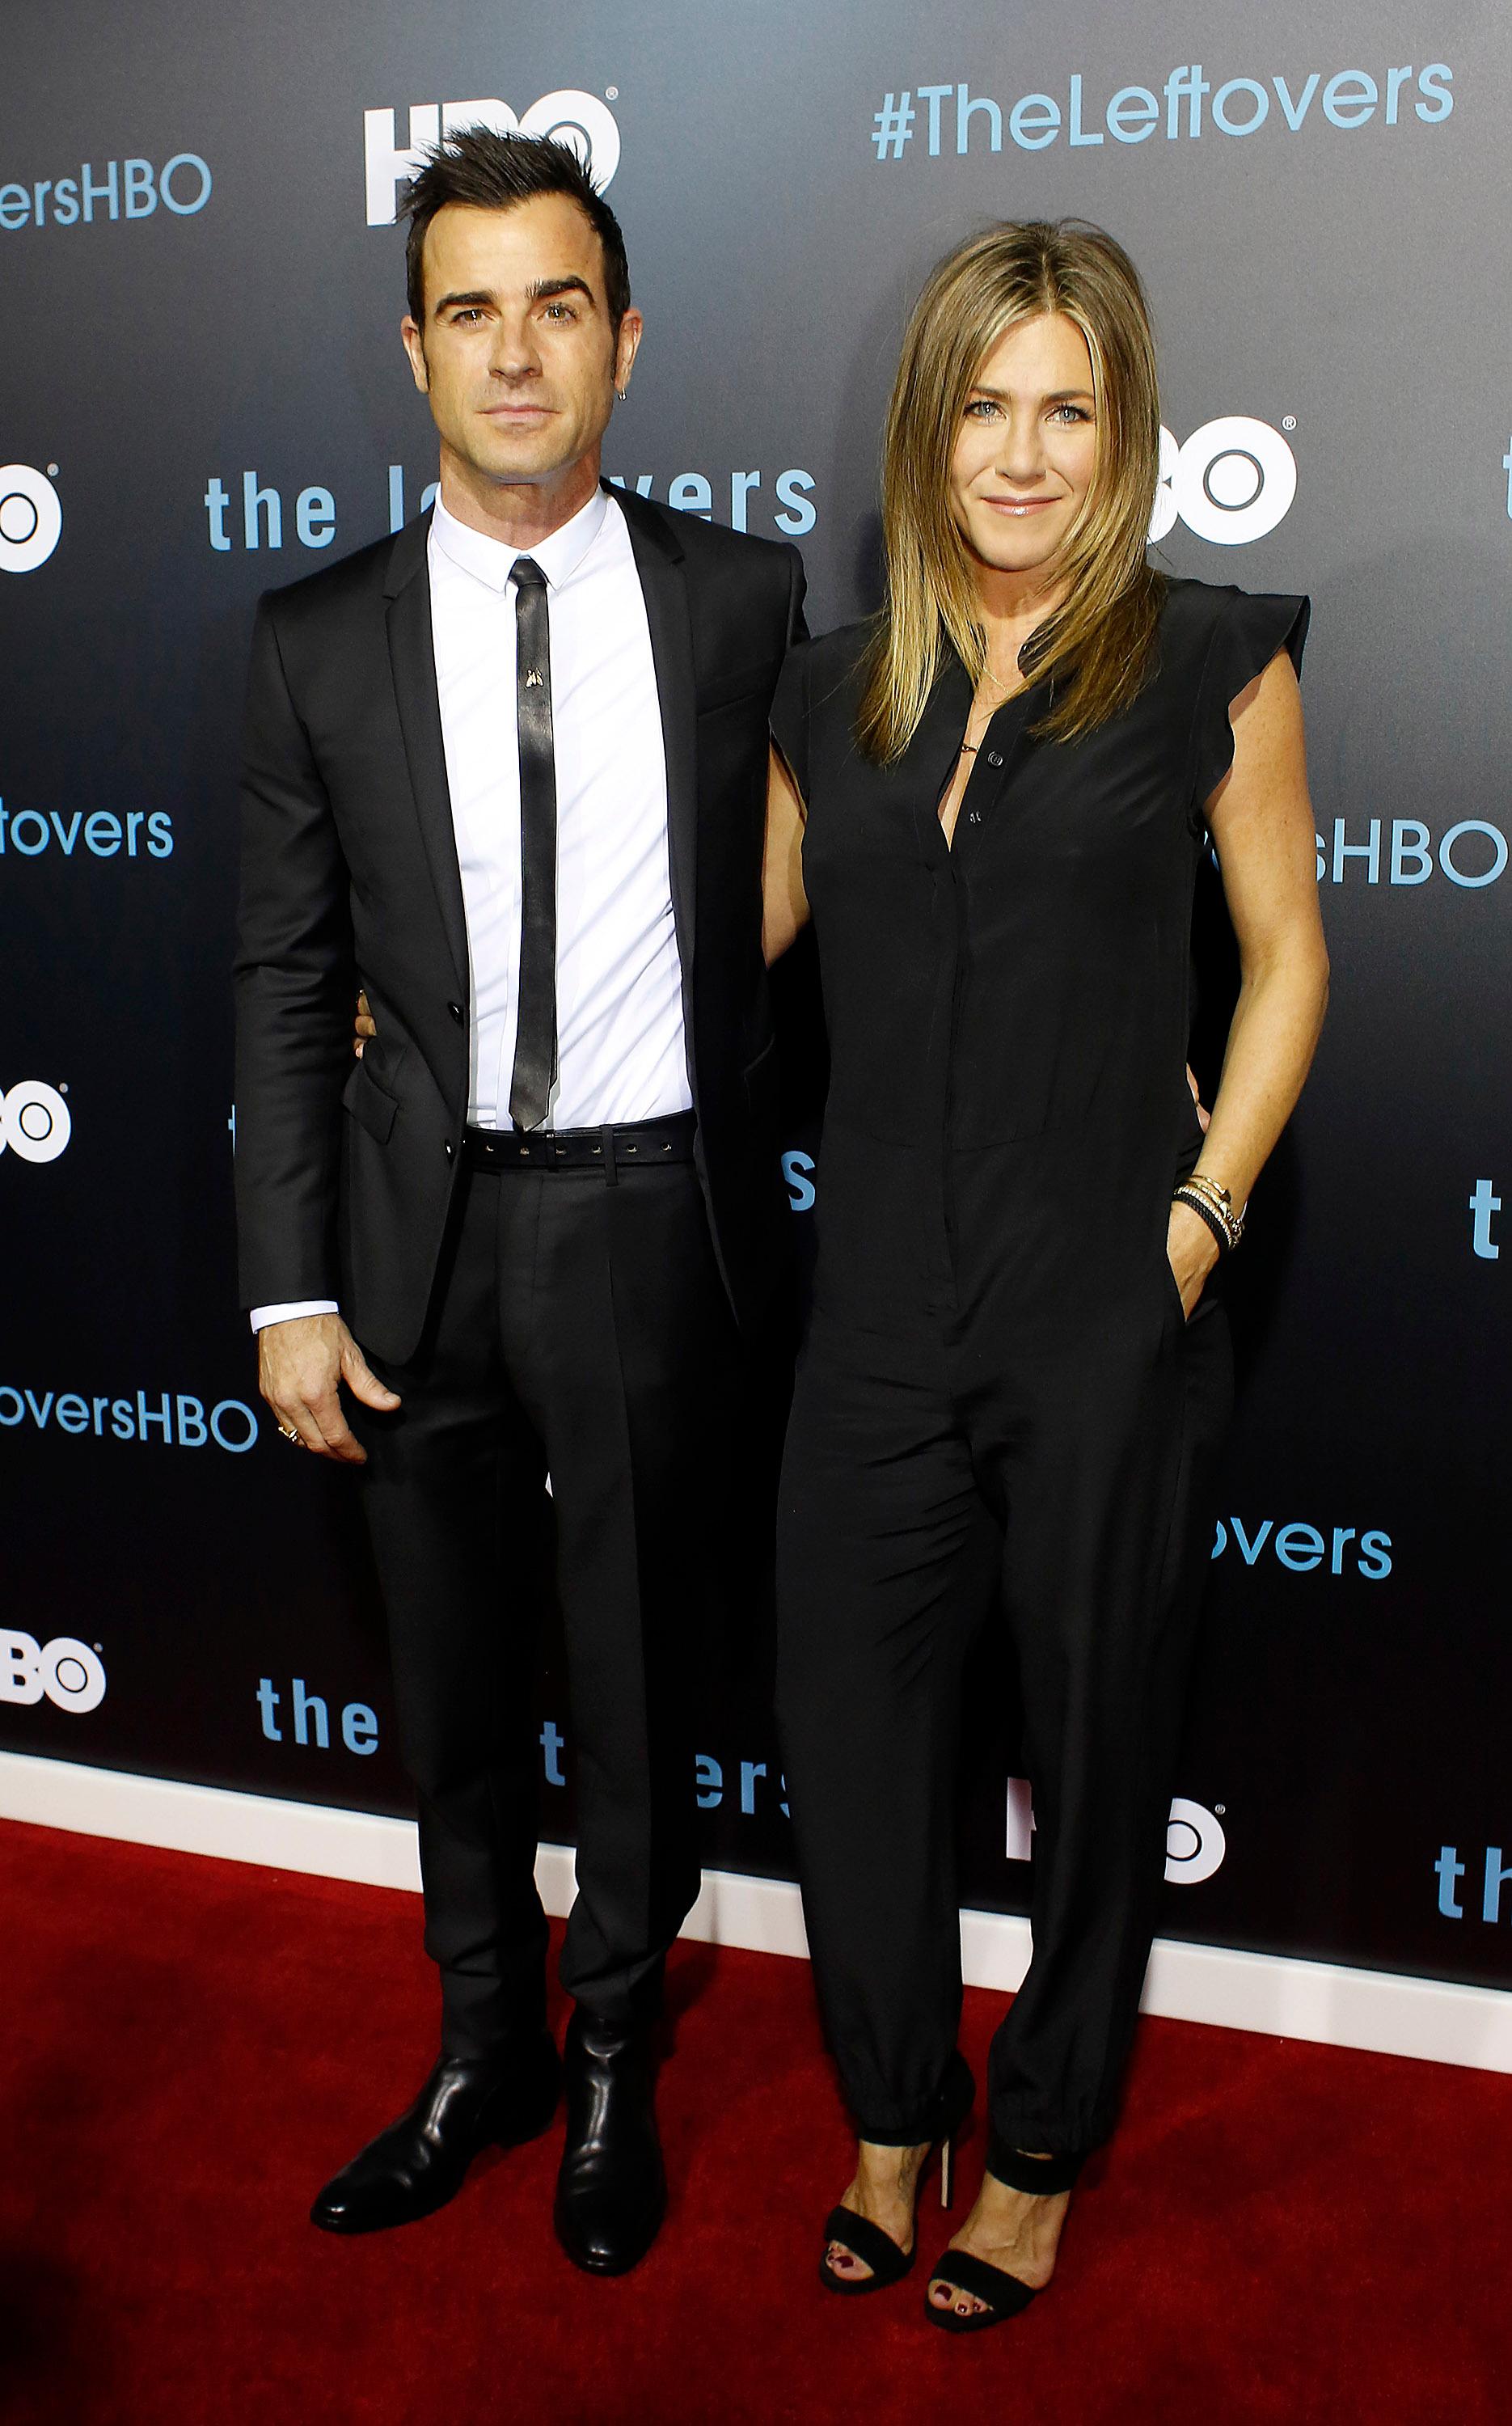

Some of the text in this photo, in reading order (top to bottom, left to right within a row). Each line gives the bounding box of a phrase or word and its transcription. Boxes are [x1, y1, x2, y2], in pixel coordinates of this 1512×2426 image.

[871, 63, 1455, 160] #TheLeftovers
[0, 153, 213, 230] ersHBO
[205, 471, 336, 552] the
[1211, 1517, 1392, 1579] vers
[256, 1678, 379, 1756] the
